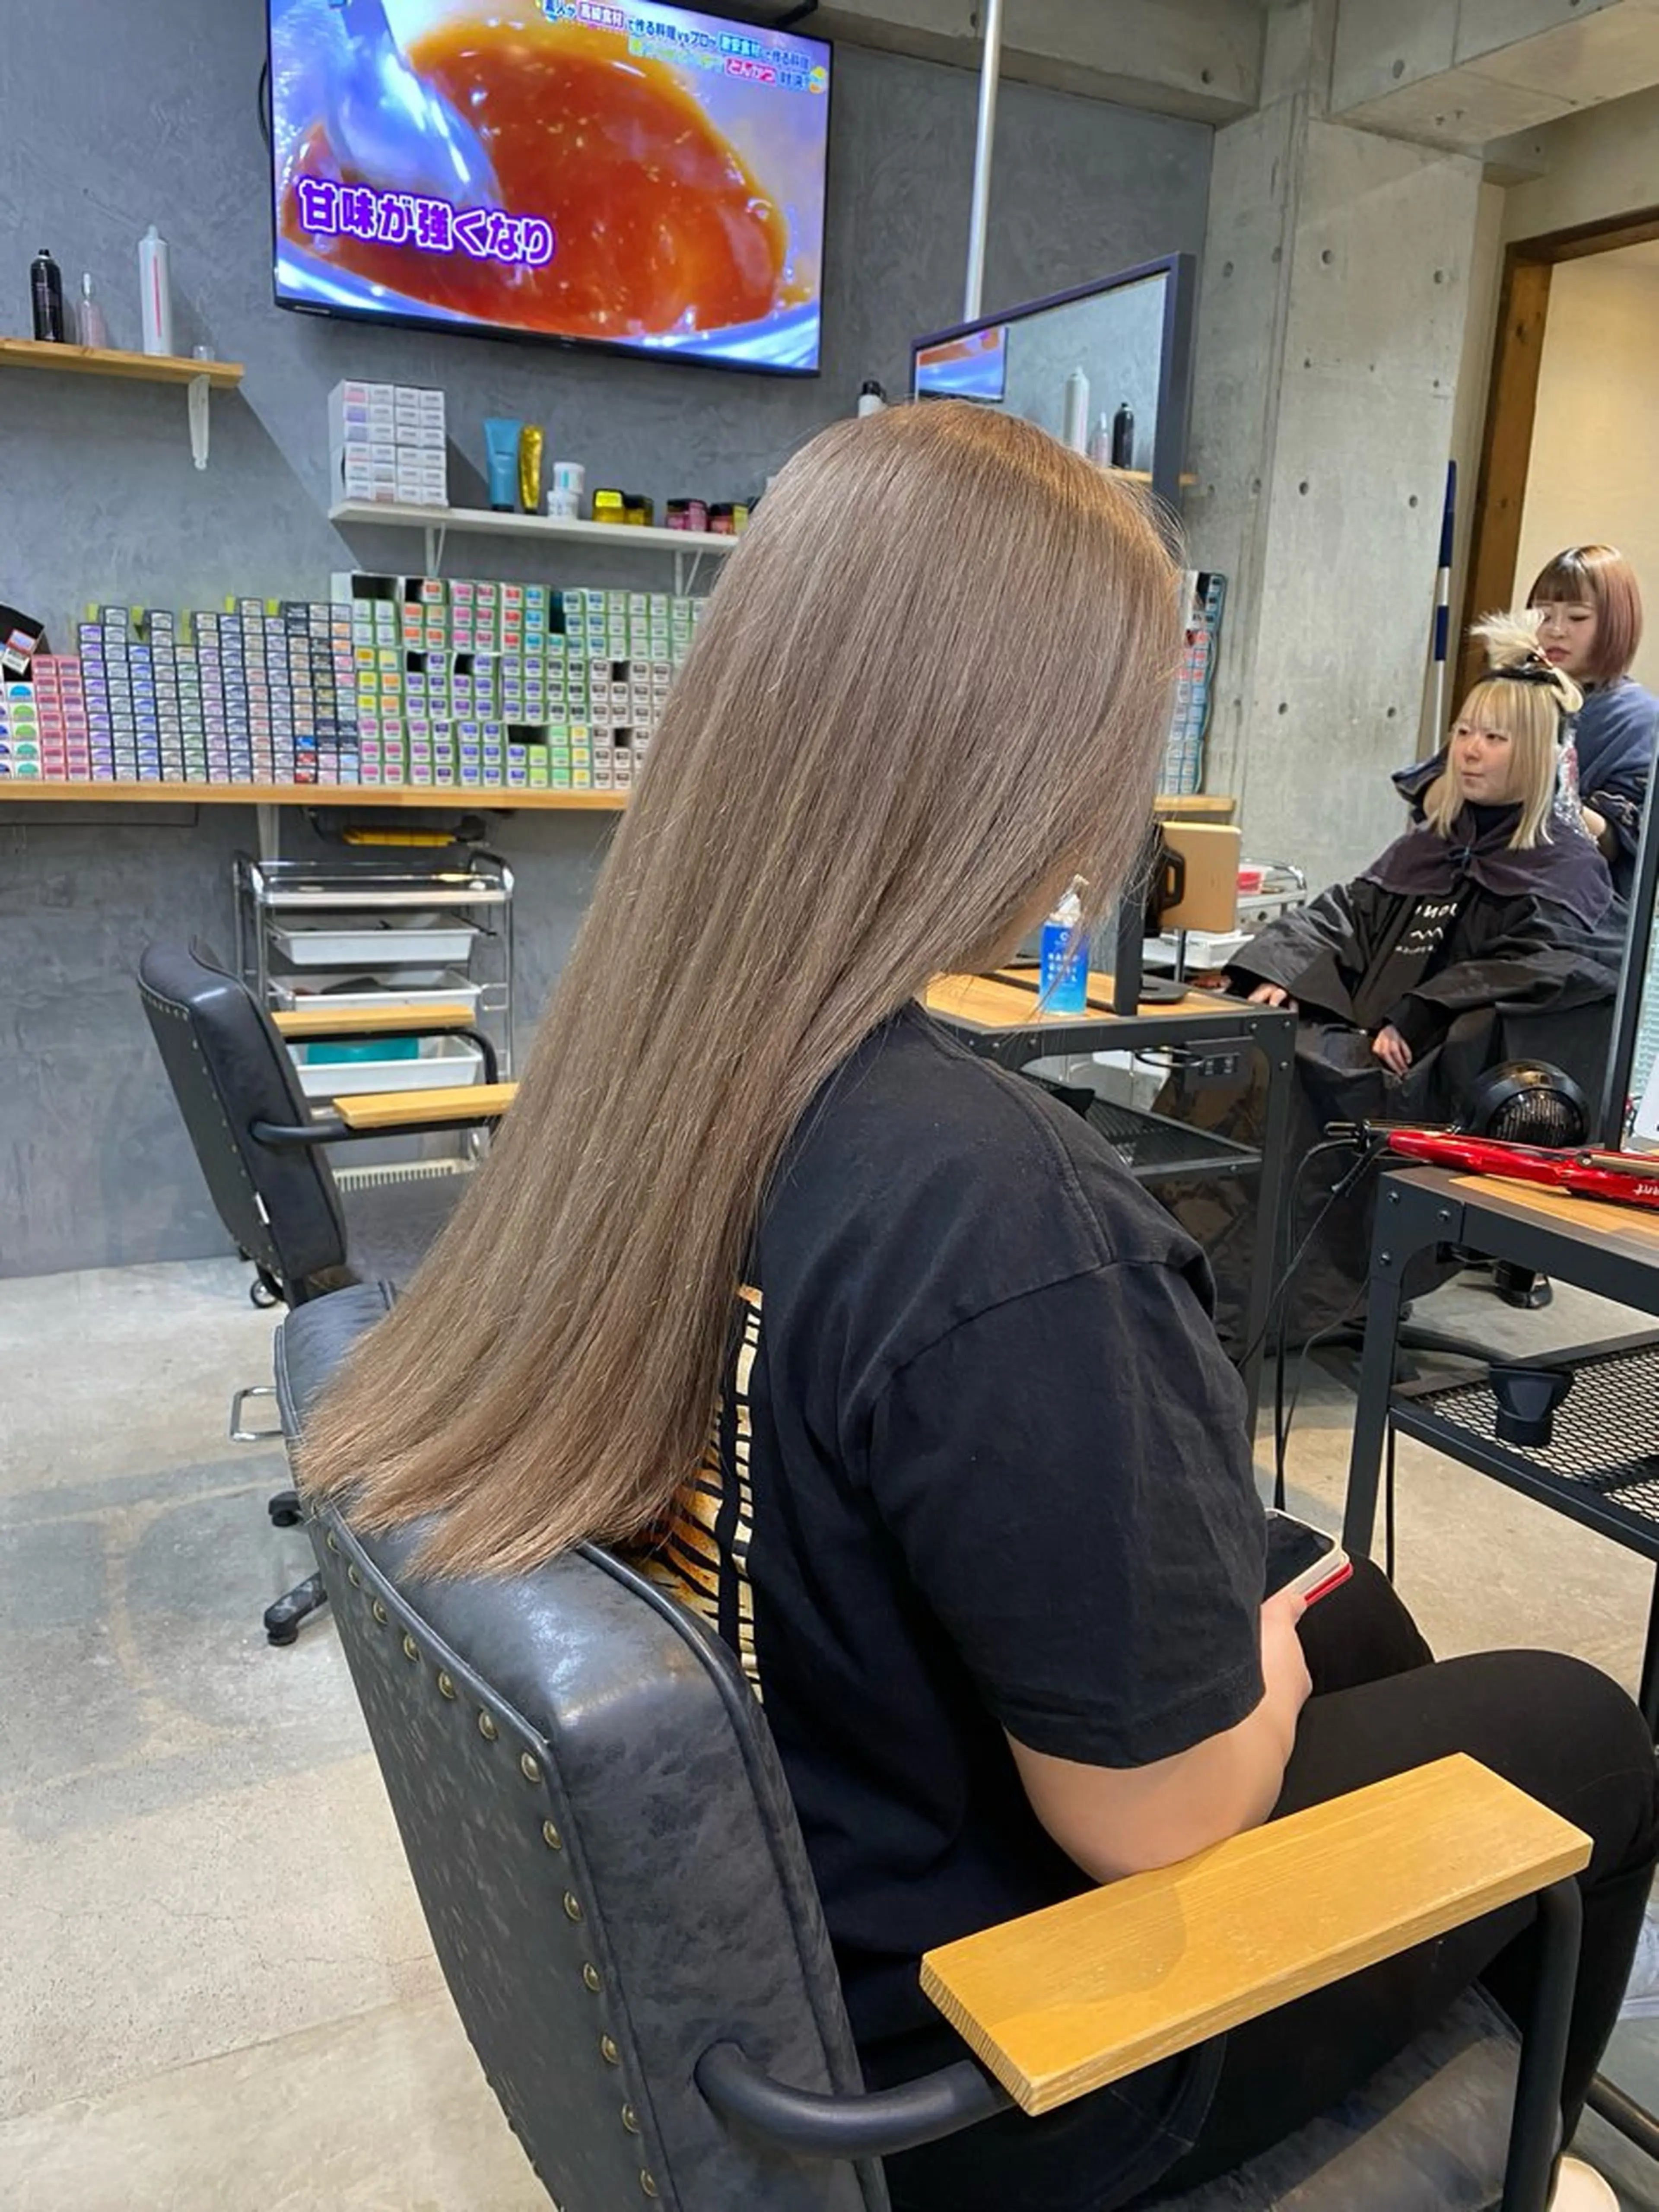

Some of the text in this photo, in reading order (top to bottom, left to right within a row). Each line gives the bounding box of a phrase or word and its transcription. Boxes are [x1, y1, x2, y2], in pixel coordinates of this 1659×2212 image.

[300, 180, 553, 264] 甘味が強くなり
